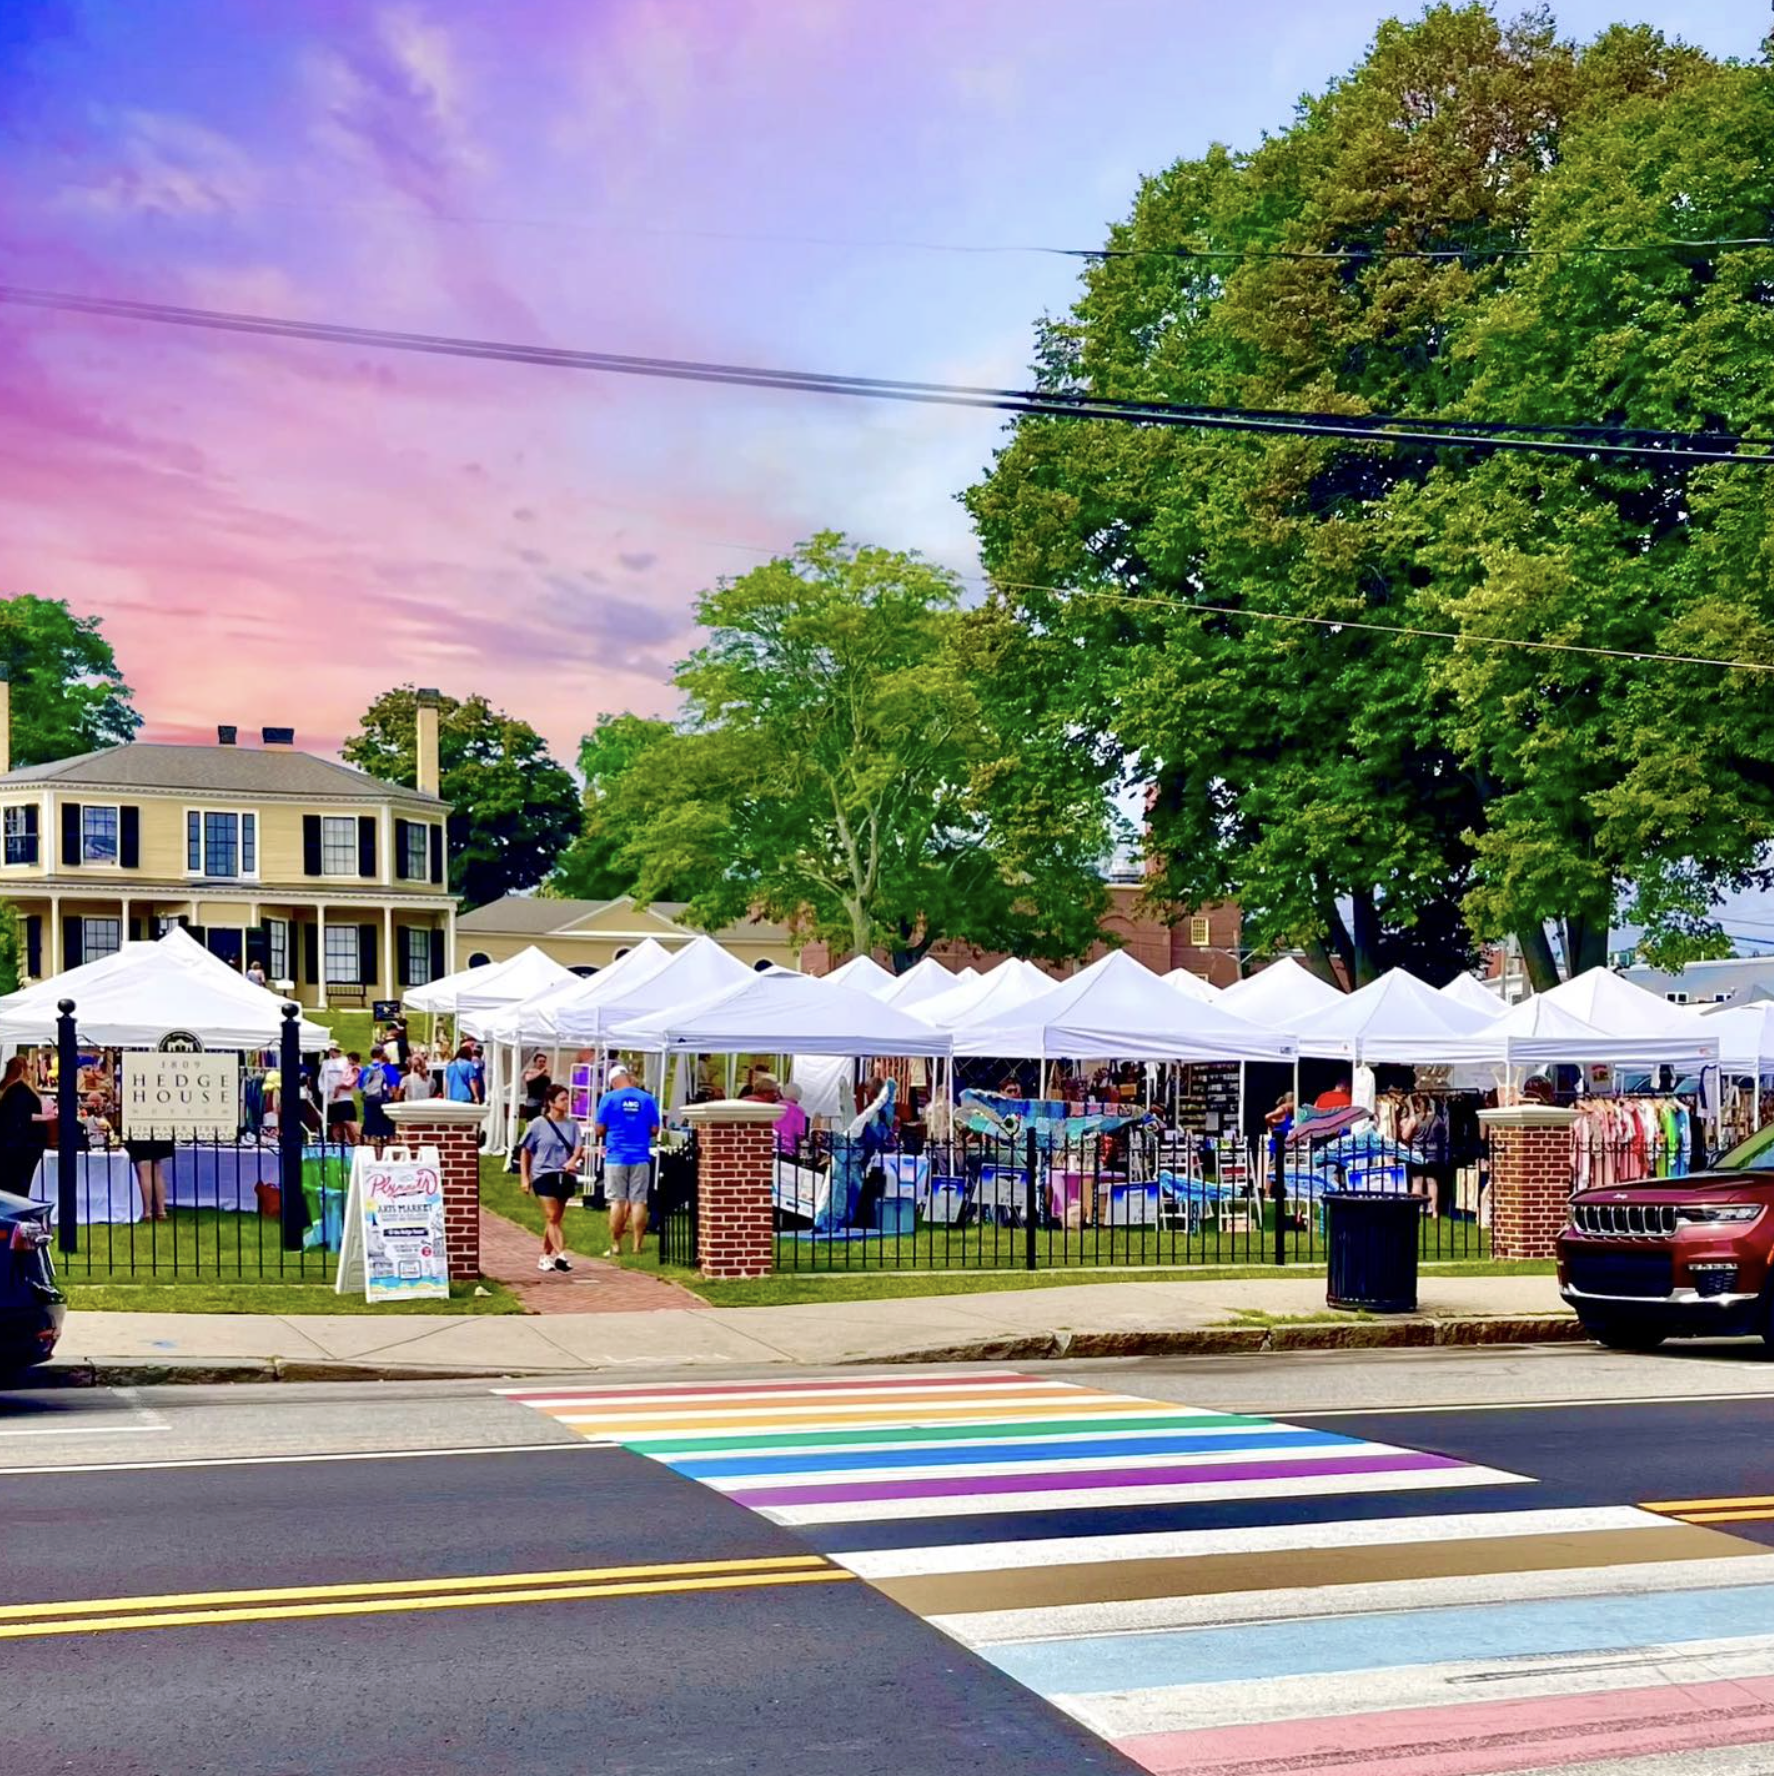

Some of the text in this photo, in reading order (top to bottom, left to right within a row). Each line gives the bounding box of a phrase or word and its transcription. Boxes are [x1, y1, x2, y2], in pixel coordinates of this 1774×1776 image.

[161, 1061, 201, 1070] 1809
[133, 1073, 229, 1087] HEDGE
[133, 1090, 229, 1104] HOUSE
[398, 1203, 433, 1213] MARKET
